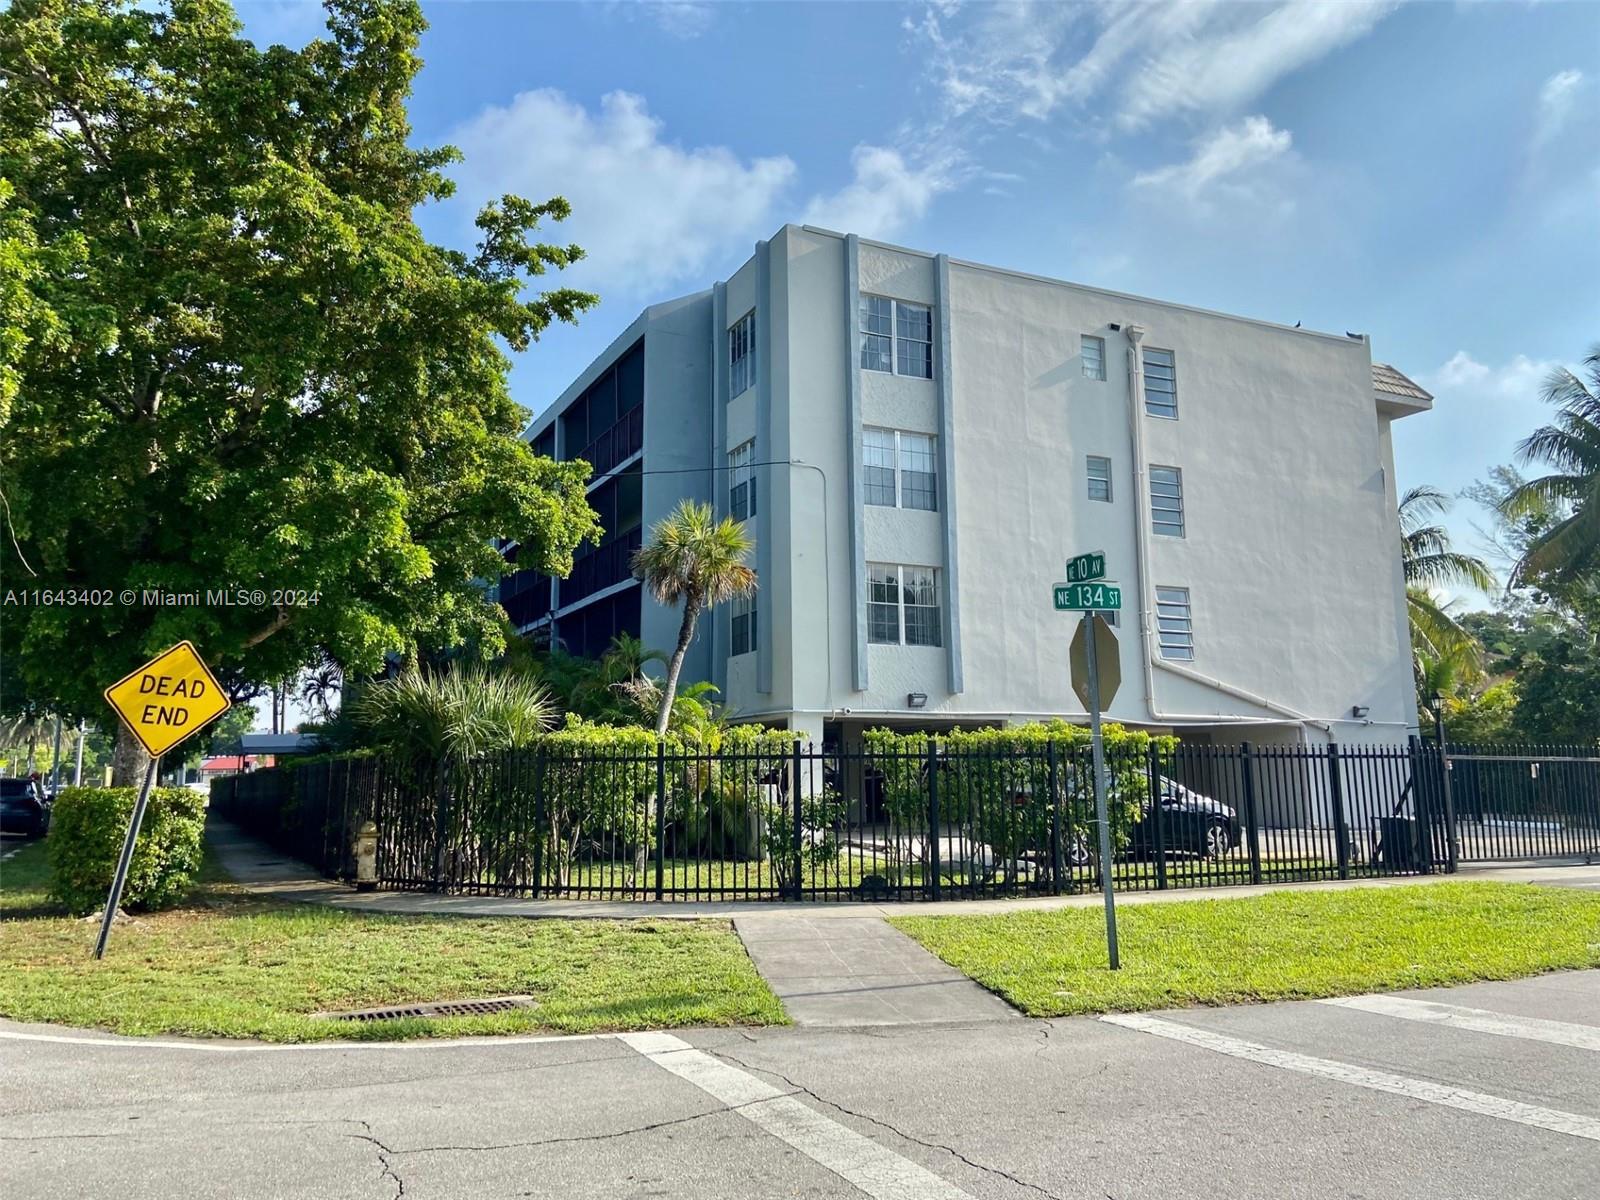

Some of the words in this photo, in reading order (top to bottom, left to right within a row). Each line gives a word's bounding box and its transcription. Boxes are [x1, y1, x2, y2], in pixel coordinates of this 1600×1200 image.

[1077, 558, 1088, 579] 10
[1092, 559, 1101, 575] AV
[1058, 591, 1070, 605] NE
[1077, 586, 1104, 607] 134
[1109, 591, 1118, 606] ST
[139, 674, 206, 699] DEAD
[141, 704, 189, 727] END
